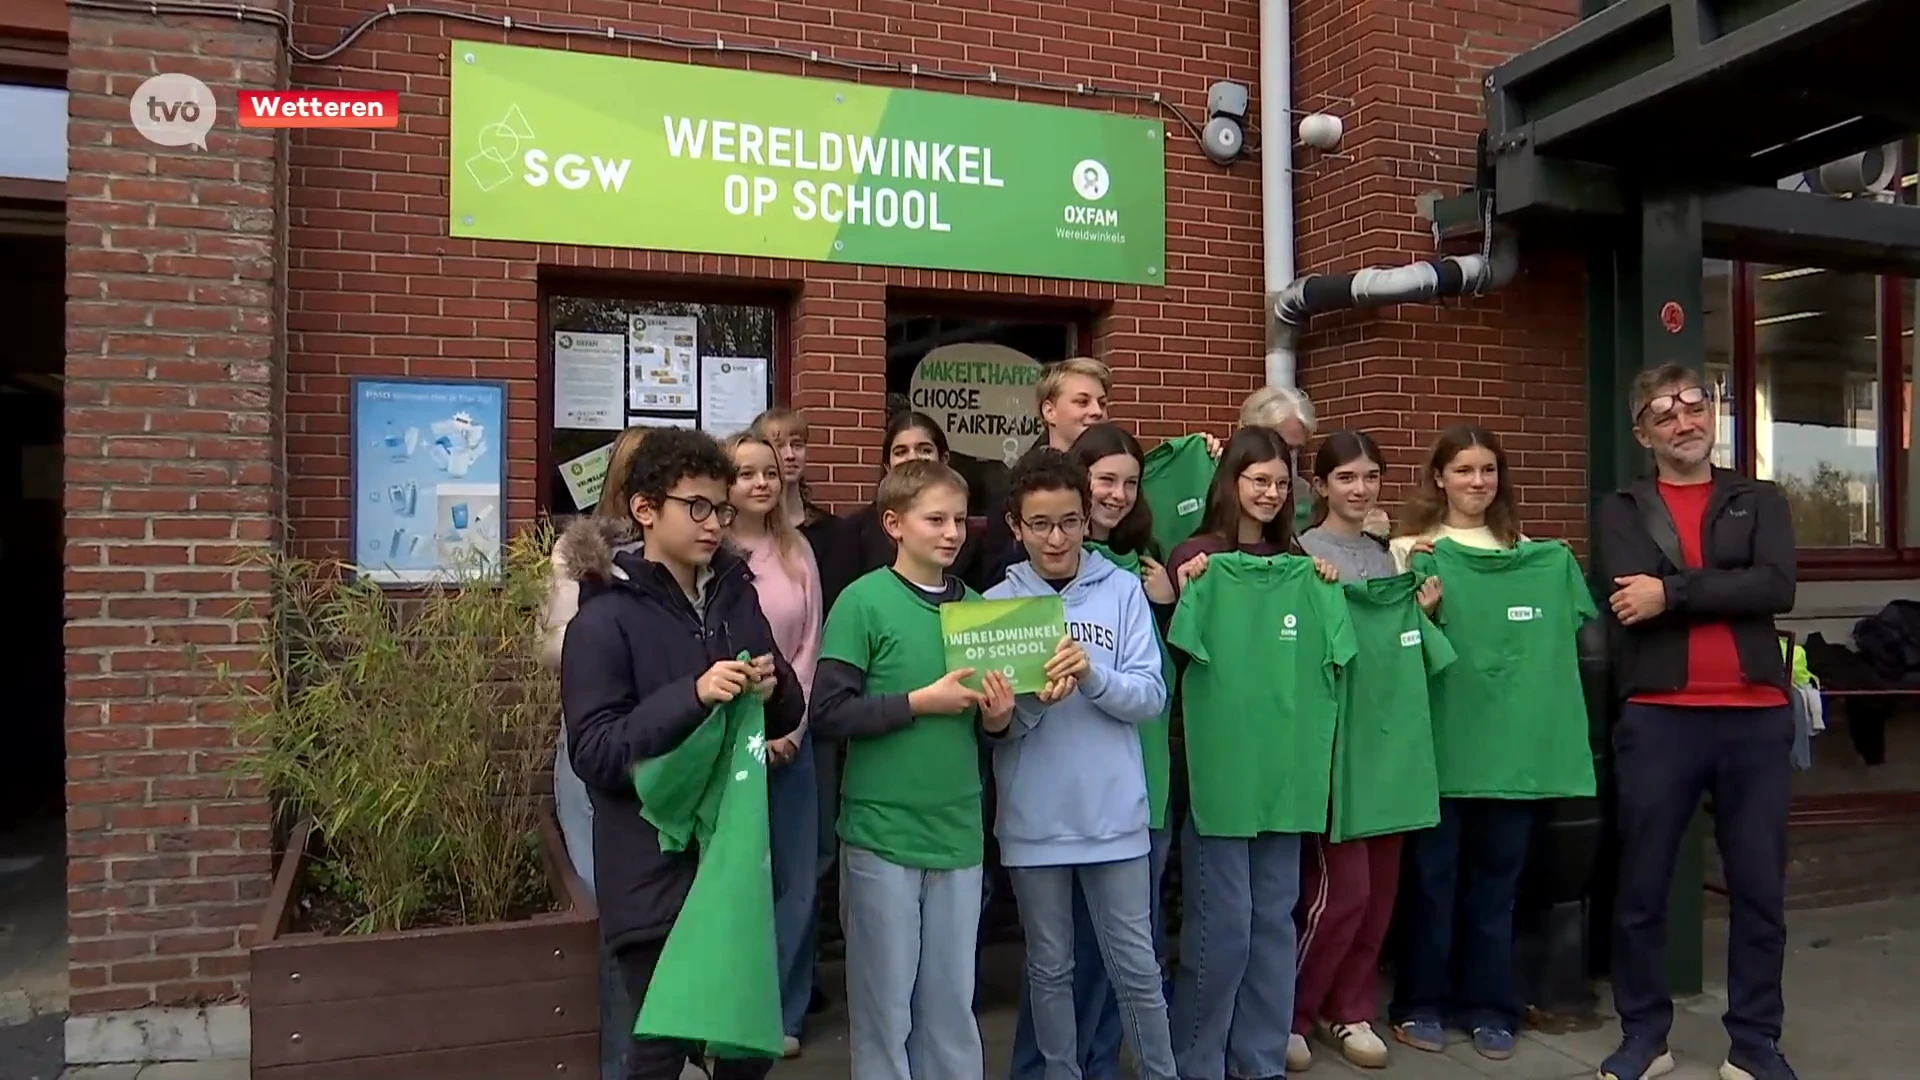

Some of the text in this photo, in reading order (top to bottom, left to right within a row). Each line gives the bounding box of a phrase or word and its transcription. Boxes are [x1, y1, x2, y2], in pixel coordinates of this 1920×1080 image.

[663, 115, 1004, 187] WERELDWINKEL
[523, 149, 632, 193] SGW
[724, 174, 951, 232] OP SCHOOL
[1064, 205, 1118, 227] OXFAM
[1056, 227, 1126, 244] Wereldwinkels
[912, 388, 981, 410] CHOOSE
[947, 413, 1042, 436] FAIRTRADE
[949, 624, 1060, 645] WERELDWINKEL
[965, 642, 1047, 660] OP SCHOOL
